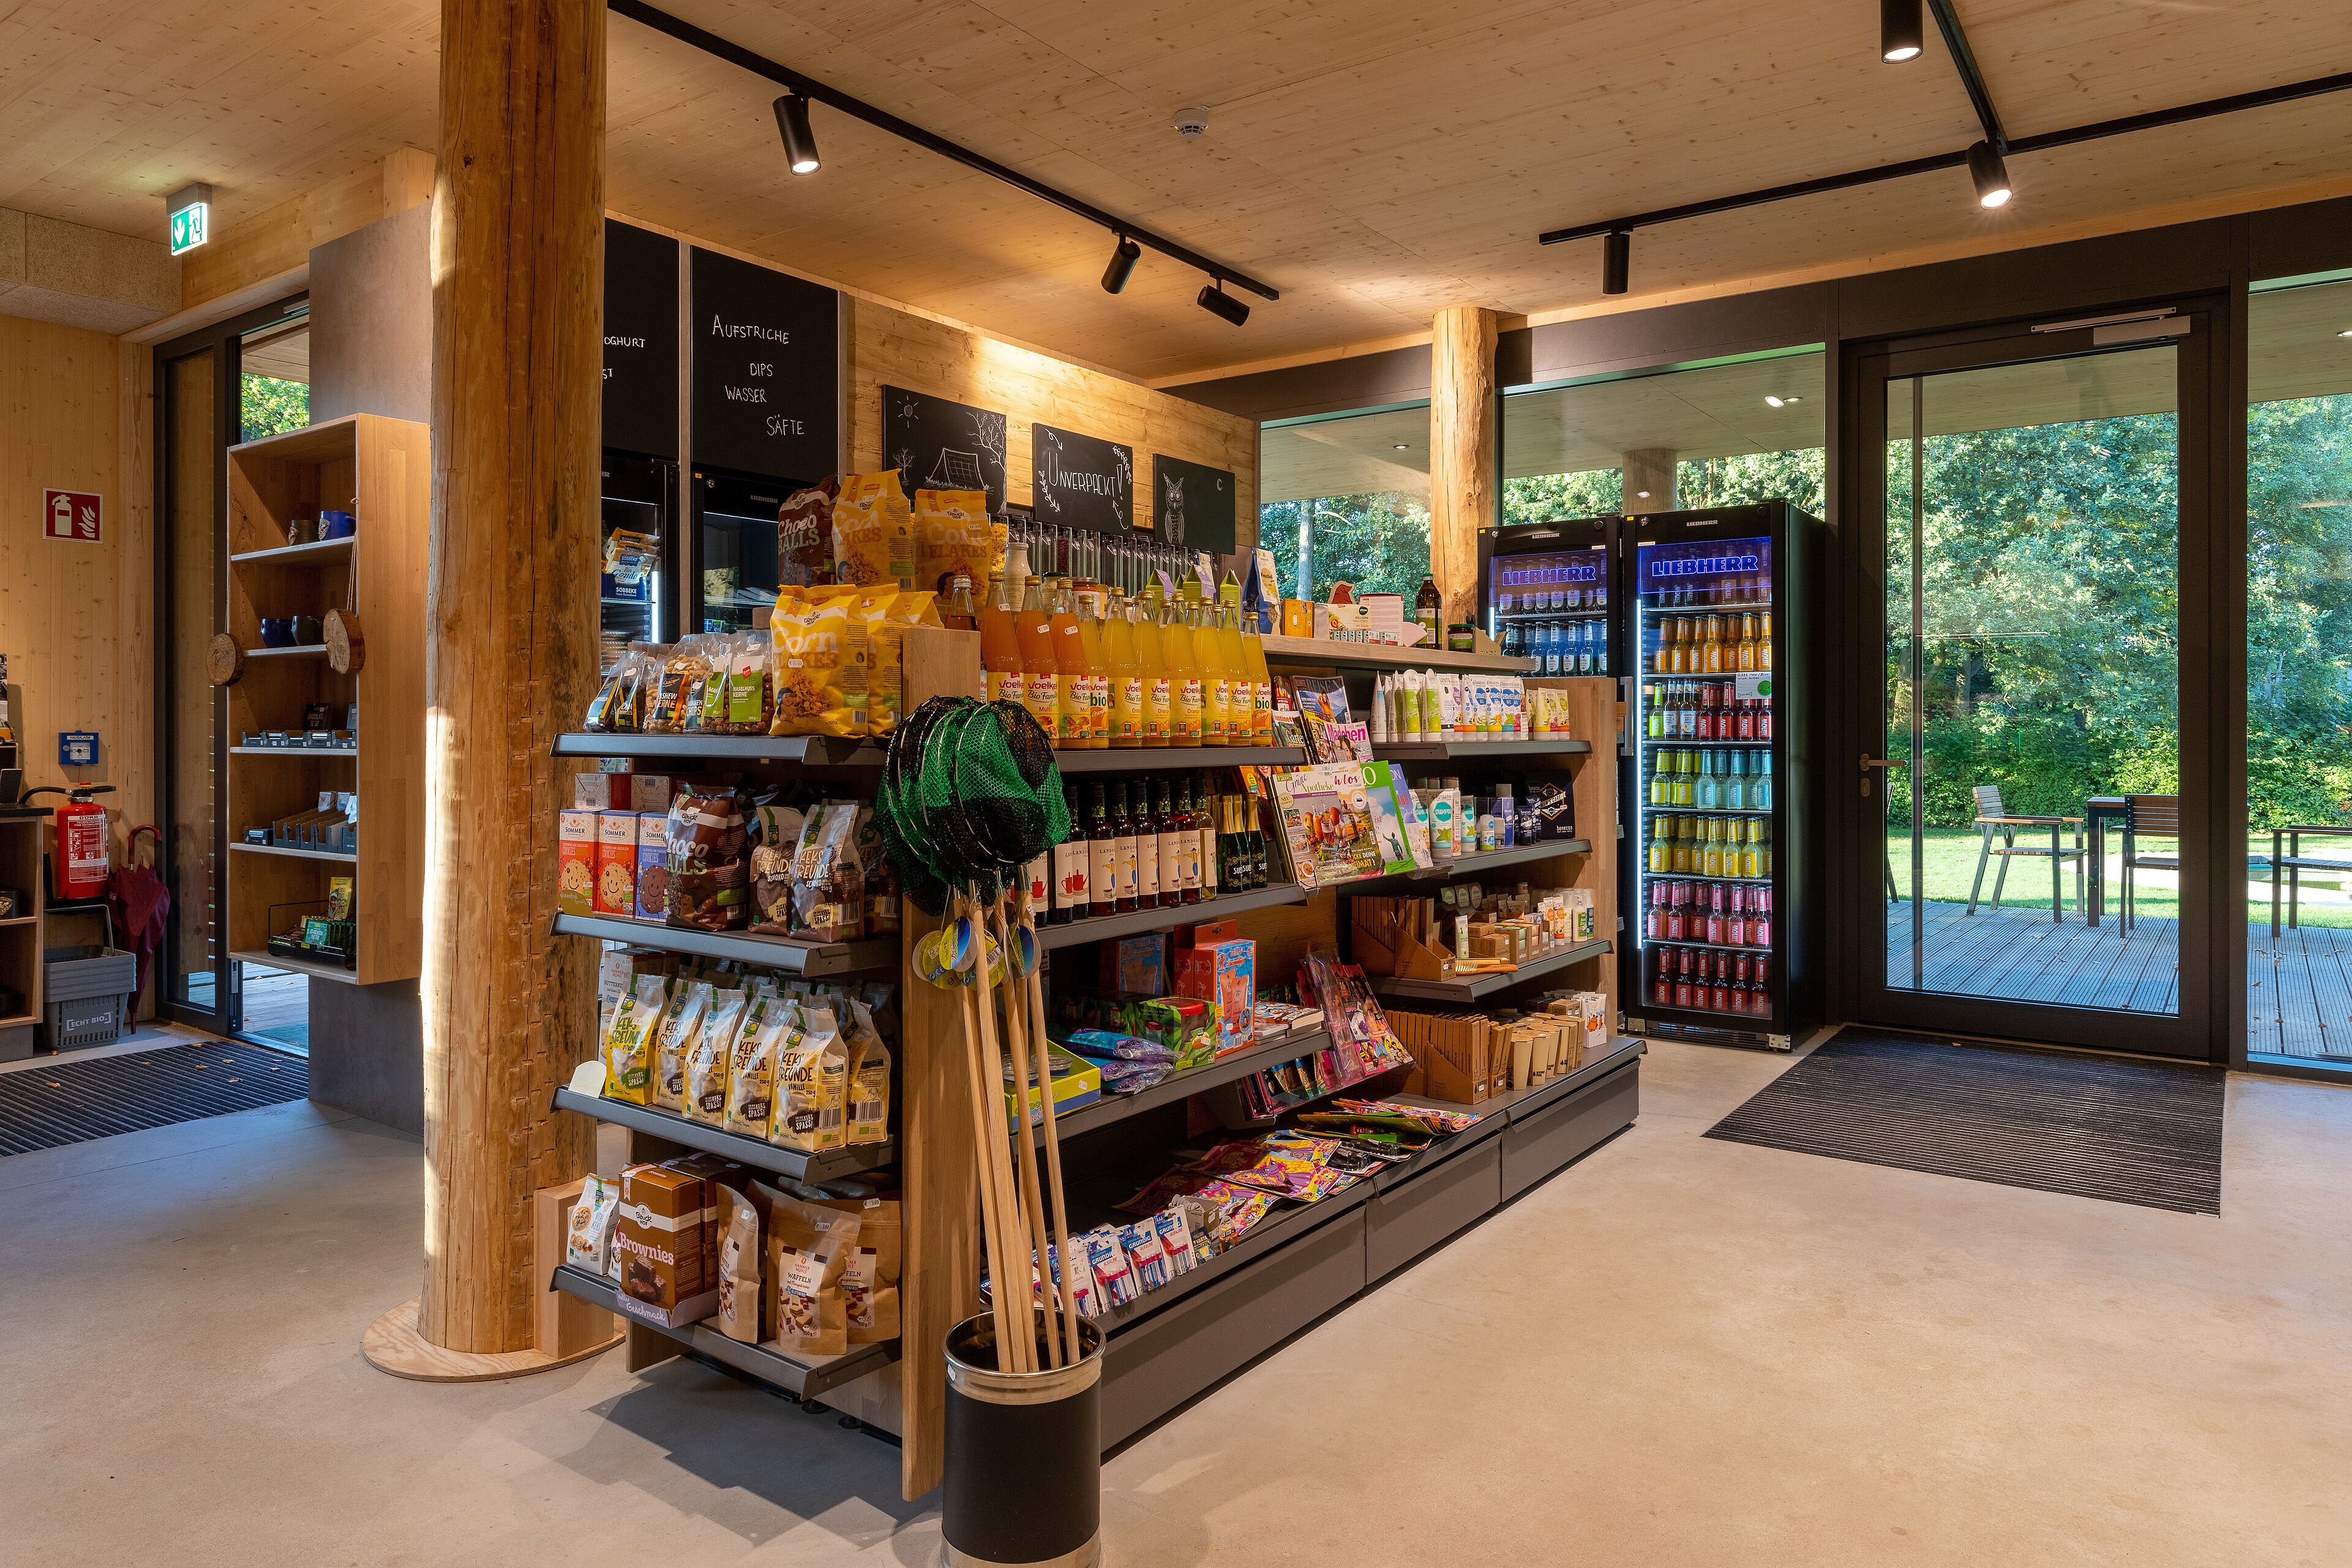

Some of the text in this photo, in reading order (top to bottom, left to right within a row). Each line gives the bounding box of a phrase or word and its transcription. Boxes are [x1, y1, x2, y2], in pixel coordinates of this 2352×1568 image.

[712, 313, 790, 345] AUFSTRICHE
[604, 336, 646, 349] OGHURT
[750, 363, 774, 377] DIPS
[725, 385, 767, 403] WASSER
[766, 414, 805, 436] SÄFTE
[1048, 451, 1125, 500] UNVERPACKT!
[750, 495, 778, 504] LIEBHERR
[1686, 519, 1719, 527] LIEBHERR
[928, 545, 987, 559] FLAKES
[1652, 554, 1759, 577] LIEBHERR
[611, 569, 638, 579] Gouda
[1502, 565, 1596, 586] LIEBHERR
[772, 627, 839, 654] Corn
[998, 688, 1011, 699] Bio
[1027, 689, 1040, 699] Bio
[1069, 690, 1082, 700] Bio
[1090, 693, 1106, 706] bio
[1151, 693, 1161, 702] Bio
[1180, 694, 1191, 703] Bio
[1231, 695, 1242, 704] Bio
[1255, 697, 1270, 709] bio
[1301, 781, 1334, 795] Apotheke
[562, 847, 576, 856] COOKIES
[601, 850, 616, 859] COOKIES
[643, 853, 658, 862] COOKIES
[799, 850, 824, 864] KEKS
[666, 853, 707, 875] ALLS
[767, 873, 784, 883] SCHOKO
[794, 864, 830, 879] FREUNDE
[805, 879, 821, 888] SCHOKO
[665, 1020, 684, 1034] KEKS
[660, 1033, 686, 1048] FREUNDE
[698, 1036, 714, 1050] KEKS
[737, 1040, 762, 1056] KEKS
[690, 1050, 720, 1065] FREUNDE
[734, 1054, 767, 1071] FREUNDE
[781, 1051, 805, 1067] KEKS
[743, 1071, 759, 1080] VANILLE
[778, 1066, 813, 1082] FREUNDE
[594, 1212, 604, 1221] VITAL
[635, 1211, 652, 1223] Bauck
[590, 1221, 601, 1232] KEKS
[1169, 1227, 1183, 1237] ALKALINE
[1128, 1235, 1152, 1249] GRUNDIG
[1196, 1235, 1208, 1243] VARTA
[619, 1231, 674, 1265] Brownies
[1140, 1242, 1154, 1251] ALKALINE
[1103, 1257, 1118, 1267] ALKALINE
[788, 1272, 812, 1284] WAFFELN
[626, 1302, 666, 1321] Geschmack
